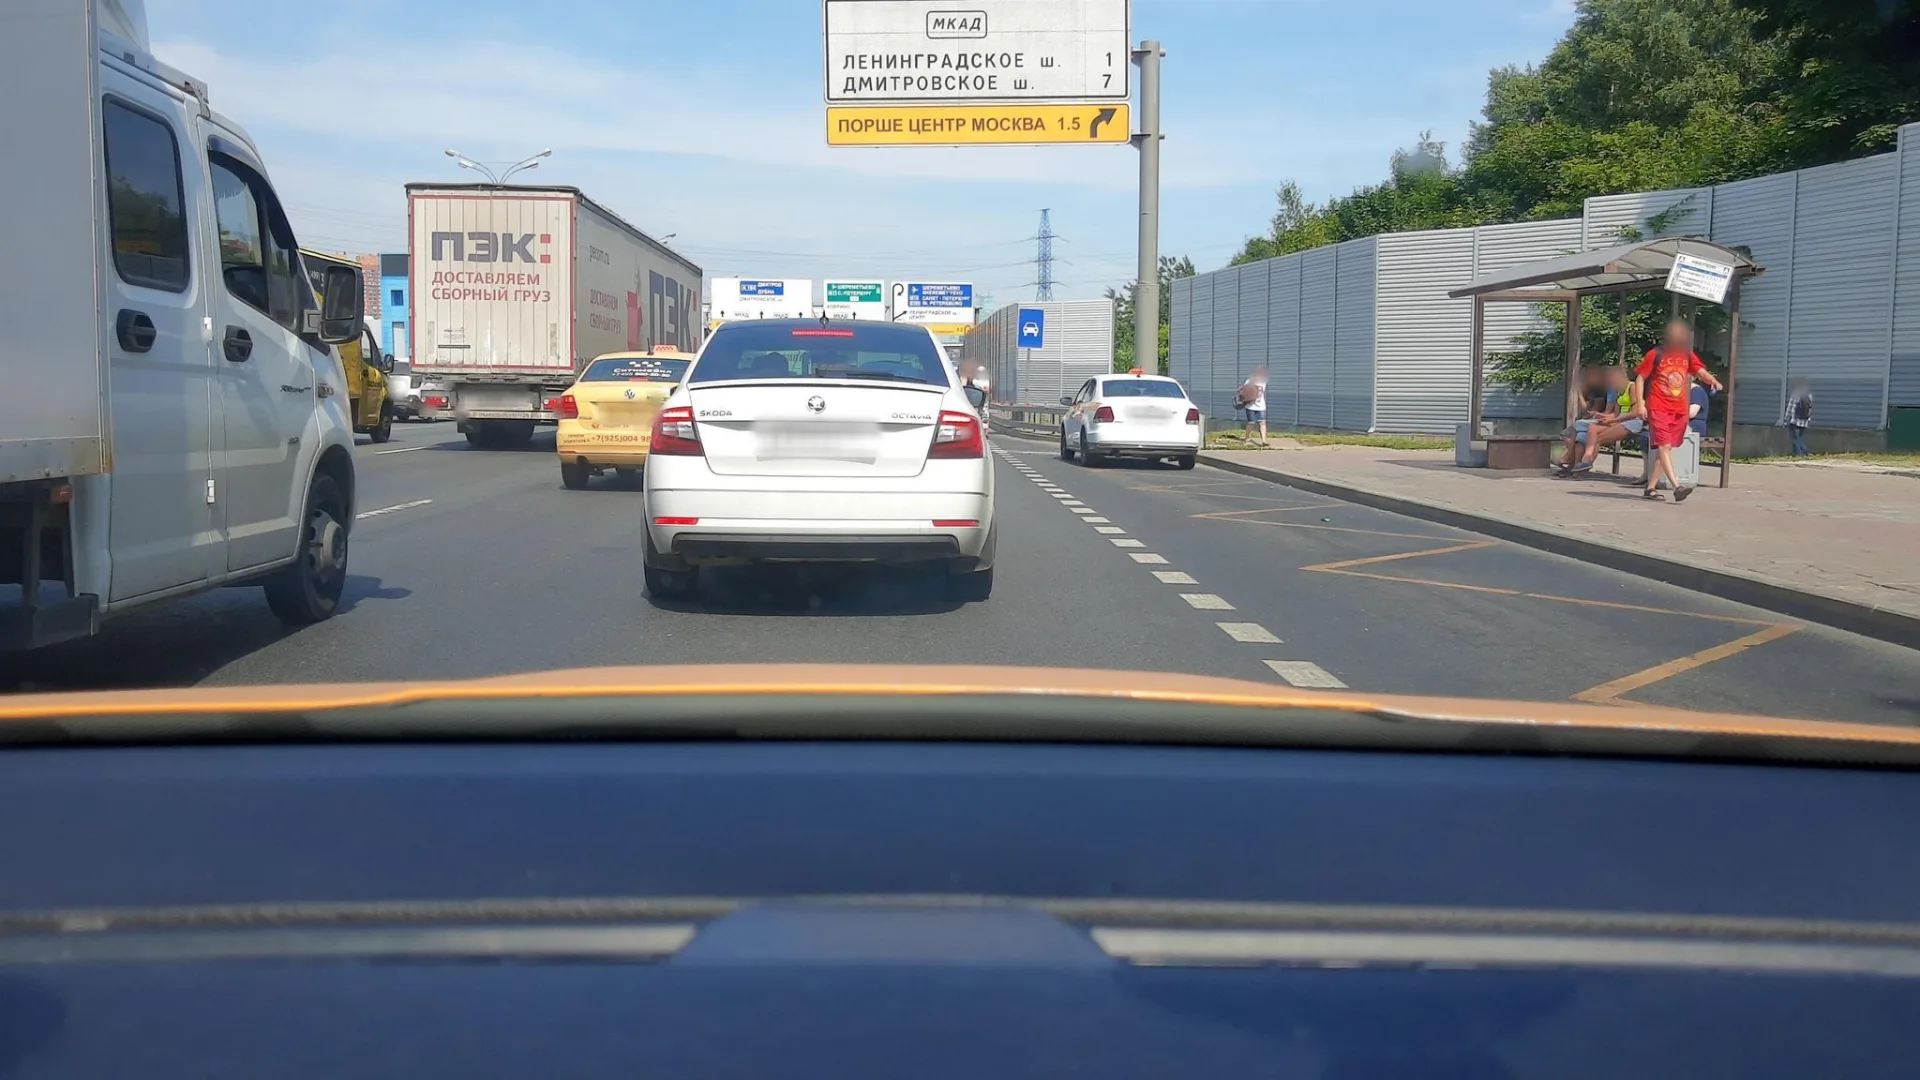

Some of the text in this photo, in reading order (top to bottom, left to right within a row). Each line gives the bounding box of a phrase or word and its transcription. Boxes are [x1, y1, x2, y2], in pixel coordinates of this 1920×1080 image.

[933, 17, 982, 31] МКАД
[843, 53, 1062, 70] ЛЕНИНГРАДСКОЕ ш.
[1105, 52, 1113, 68] 1
[843, 75, 1035, 94] ДМИТРОВСКОЕ ш.
[1102, 74, 1112, 89] 7
[838, 117, 1081, 134] ПОРШЕ ЦЕНТР МОСКВА 1.5
[431, 271, 540, 286] ДОСТАВЛЯЕМ
[431, 286, 551, 303] СБОРНЫЙ ГРУЗ
[891, 412, 932, 420] OCTAVIA
